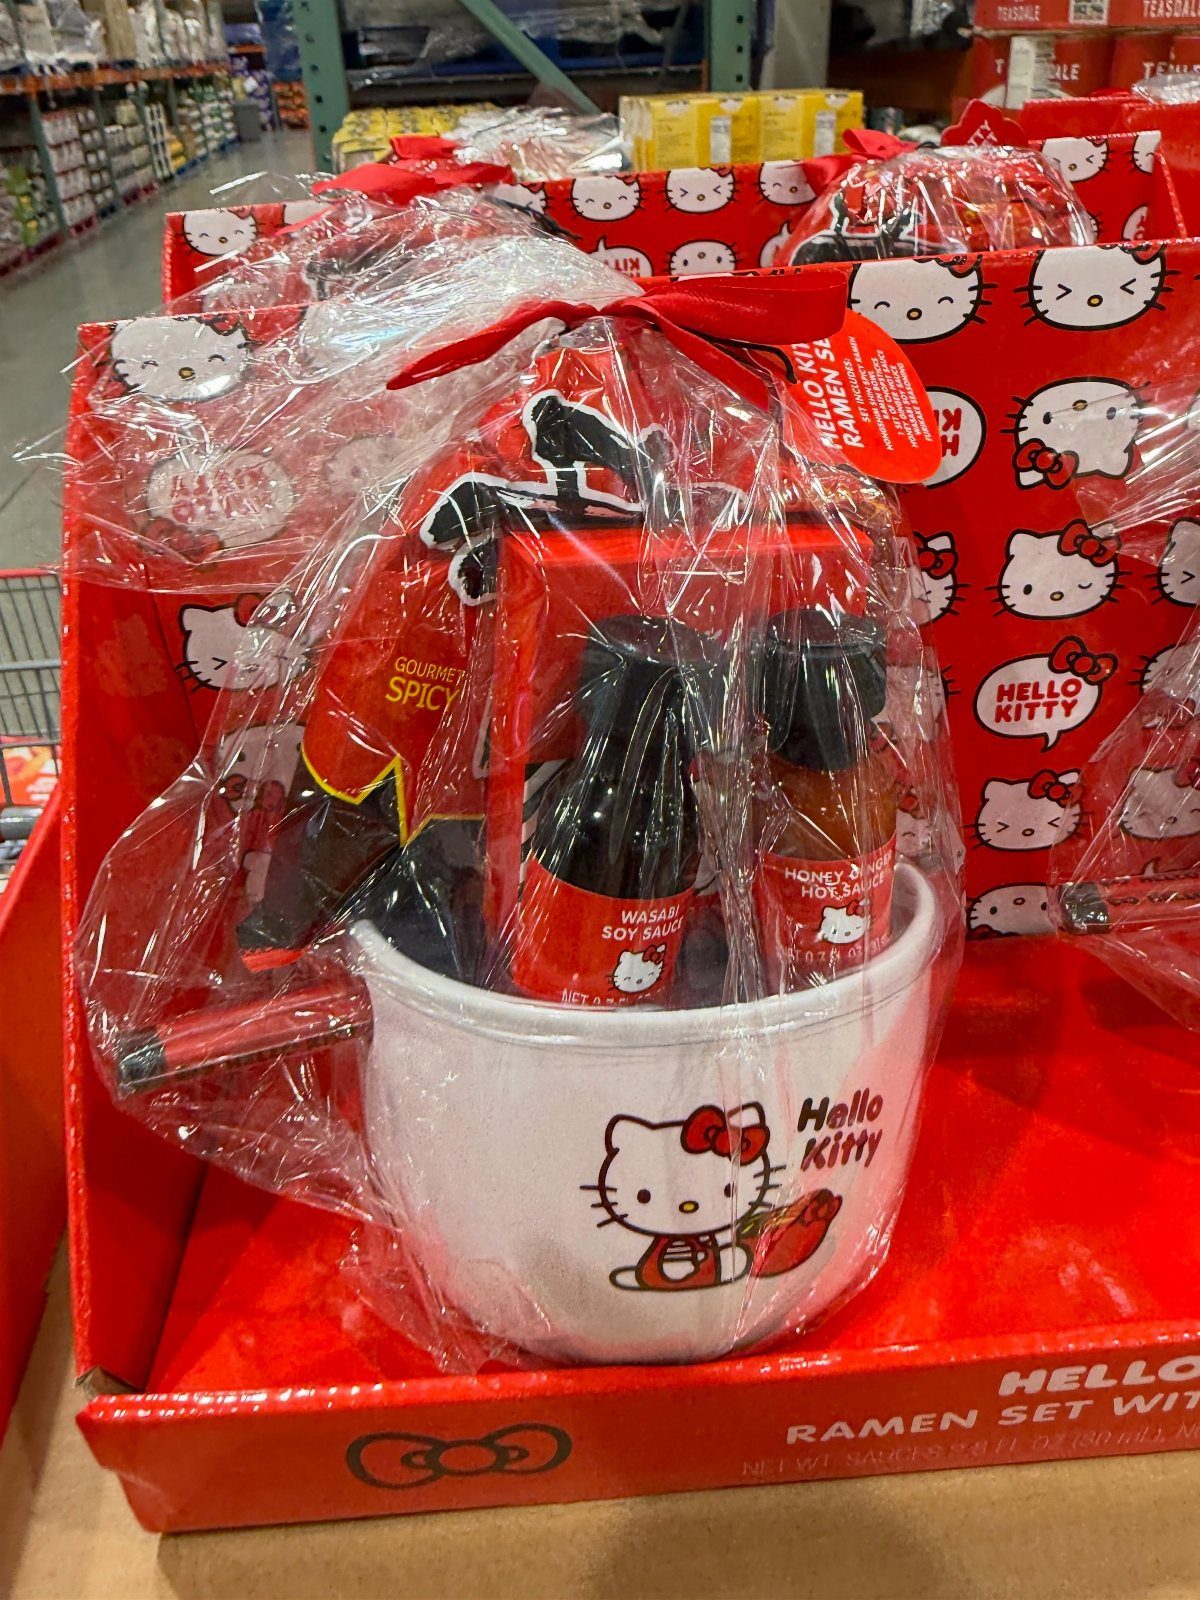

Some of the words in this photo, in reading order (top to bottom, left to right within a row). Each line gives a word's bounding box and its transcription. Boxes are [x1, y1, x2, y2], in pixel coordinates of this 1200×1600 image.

[1143, 0, 1200, 17] TEASDAL
[849, 337, 861, 362] RAMEN
[877, 350, 890, 373] SAUCE
[844, 359, 864, 404] INCLUDES:
[858, 364, 870, 385] SPICY
[868, 371, 880, 391] BOWL
[872, 358, 892, 402] CHOPSTICKS
[885, 375, 895, 389] HOT
[890, 366, 903, 388] SAUCE
[897, 363, 917, 404] SEASONING
[821, 368, 864, 447] RAMEN
[865, 387, 877, 405] SHIN
[875, 393, 890, 419] RAMEN
[892, 392, 907, 419] GINGER
[899, 390, 910, 405] SOY
[803, 380, 842, 449] HELLO
[859, 408, 870, 422] SET
[888, 405, 896, 414] OF
[905, 407, 921, 434] WASABI
[872, 408, 893, 450] NONGSHIM
[892, 417, 902, 429] SET
[903, 423, 918, 447] HONEY
[395, 656, 466, 686] GOURMET
[385, 676, 460, 711] SPICY
[996, 678, 1082, 703] HELLO
[994, 699, 1078, 723] KITTY
[785, 867, 844, 885] HONEY
[801, 885, 835, 899] HOT
[841, 870, 885, 898] SAUCE
[621, 904, 680, 925] WASABI
[601, 926, 638, 941] SOY
[797, 1087, 883, 1132] Hello
[800, 1129, 883, 1172] Kitty
[998, 1355, 1200, 1396] HELLO
[787, 1410, 978, 1444] RAMEN
[998, 1400, 1094, 1425] SET
